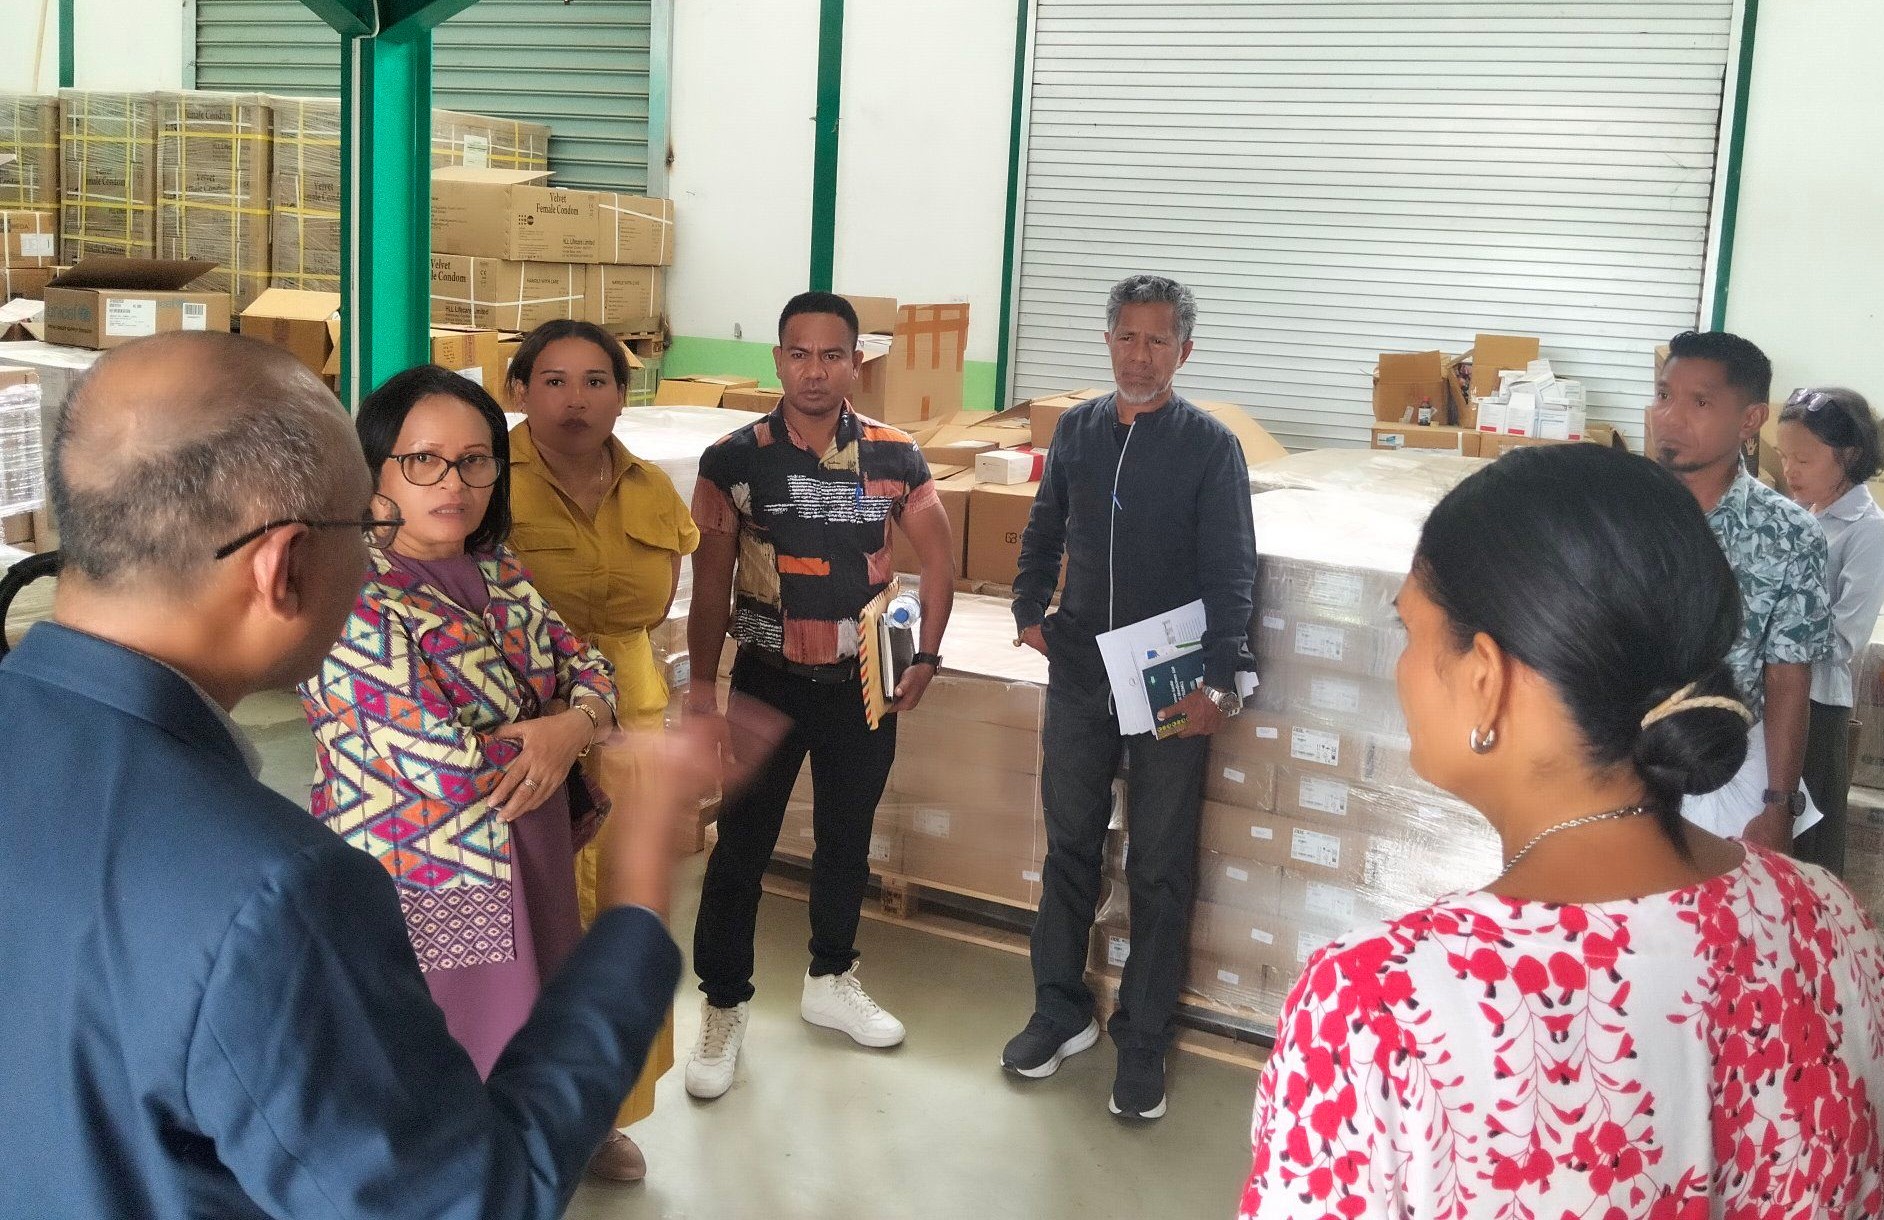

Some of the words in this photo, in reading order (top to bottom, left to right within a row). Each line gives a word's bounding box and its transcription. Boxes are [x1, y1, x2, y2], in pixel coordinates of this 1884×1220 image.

[549, 192, 567, 203] Velvet
[536, 203, 556, 214] Female
[556, 204, 578, 216] Condom
[430, 259, 450, 270] Velvet
[438, 271, 466, 282] Condom
